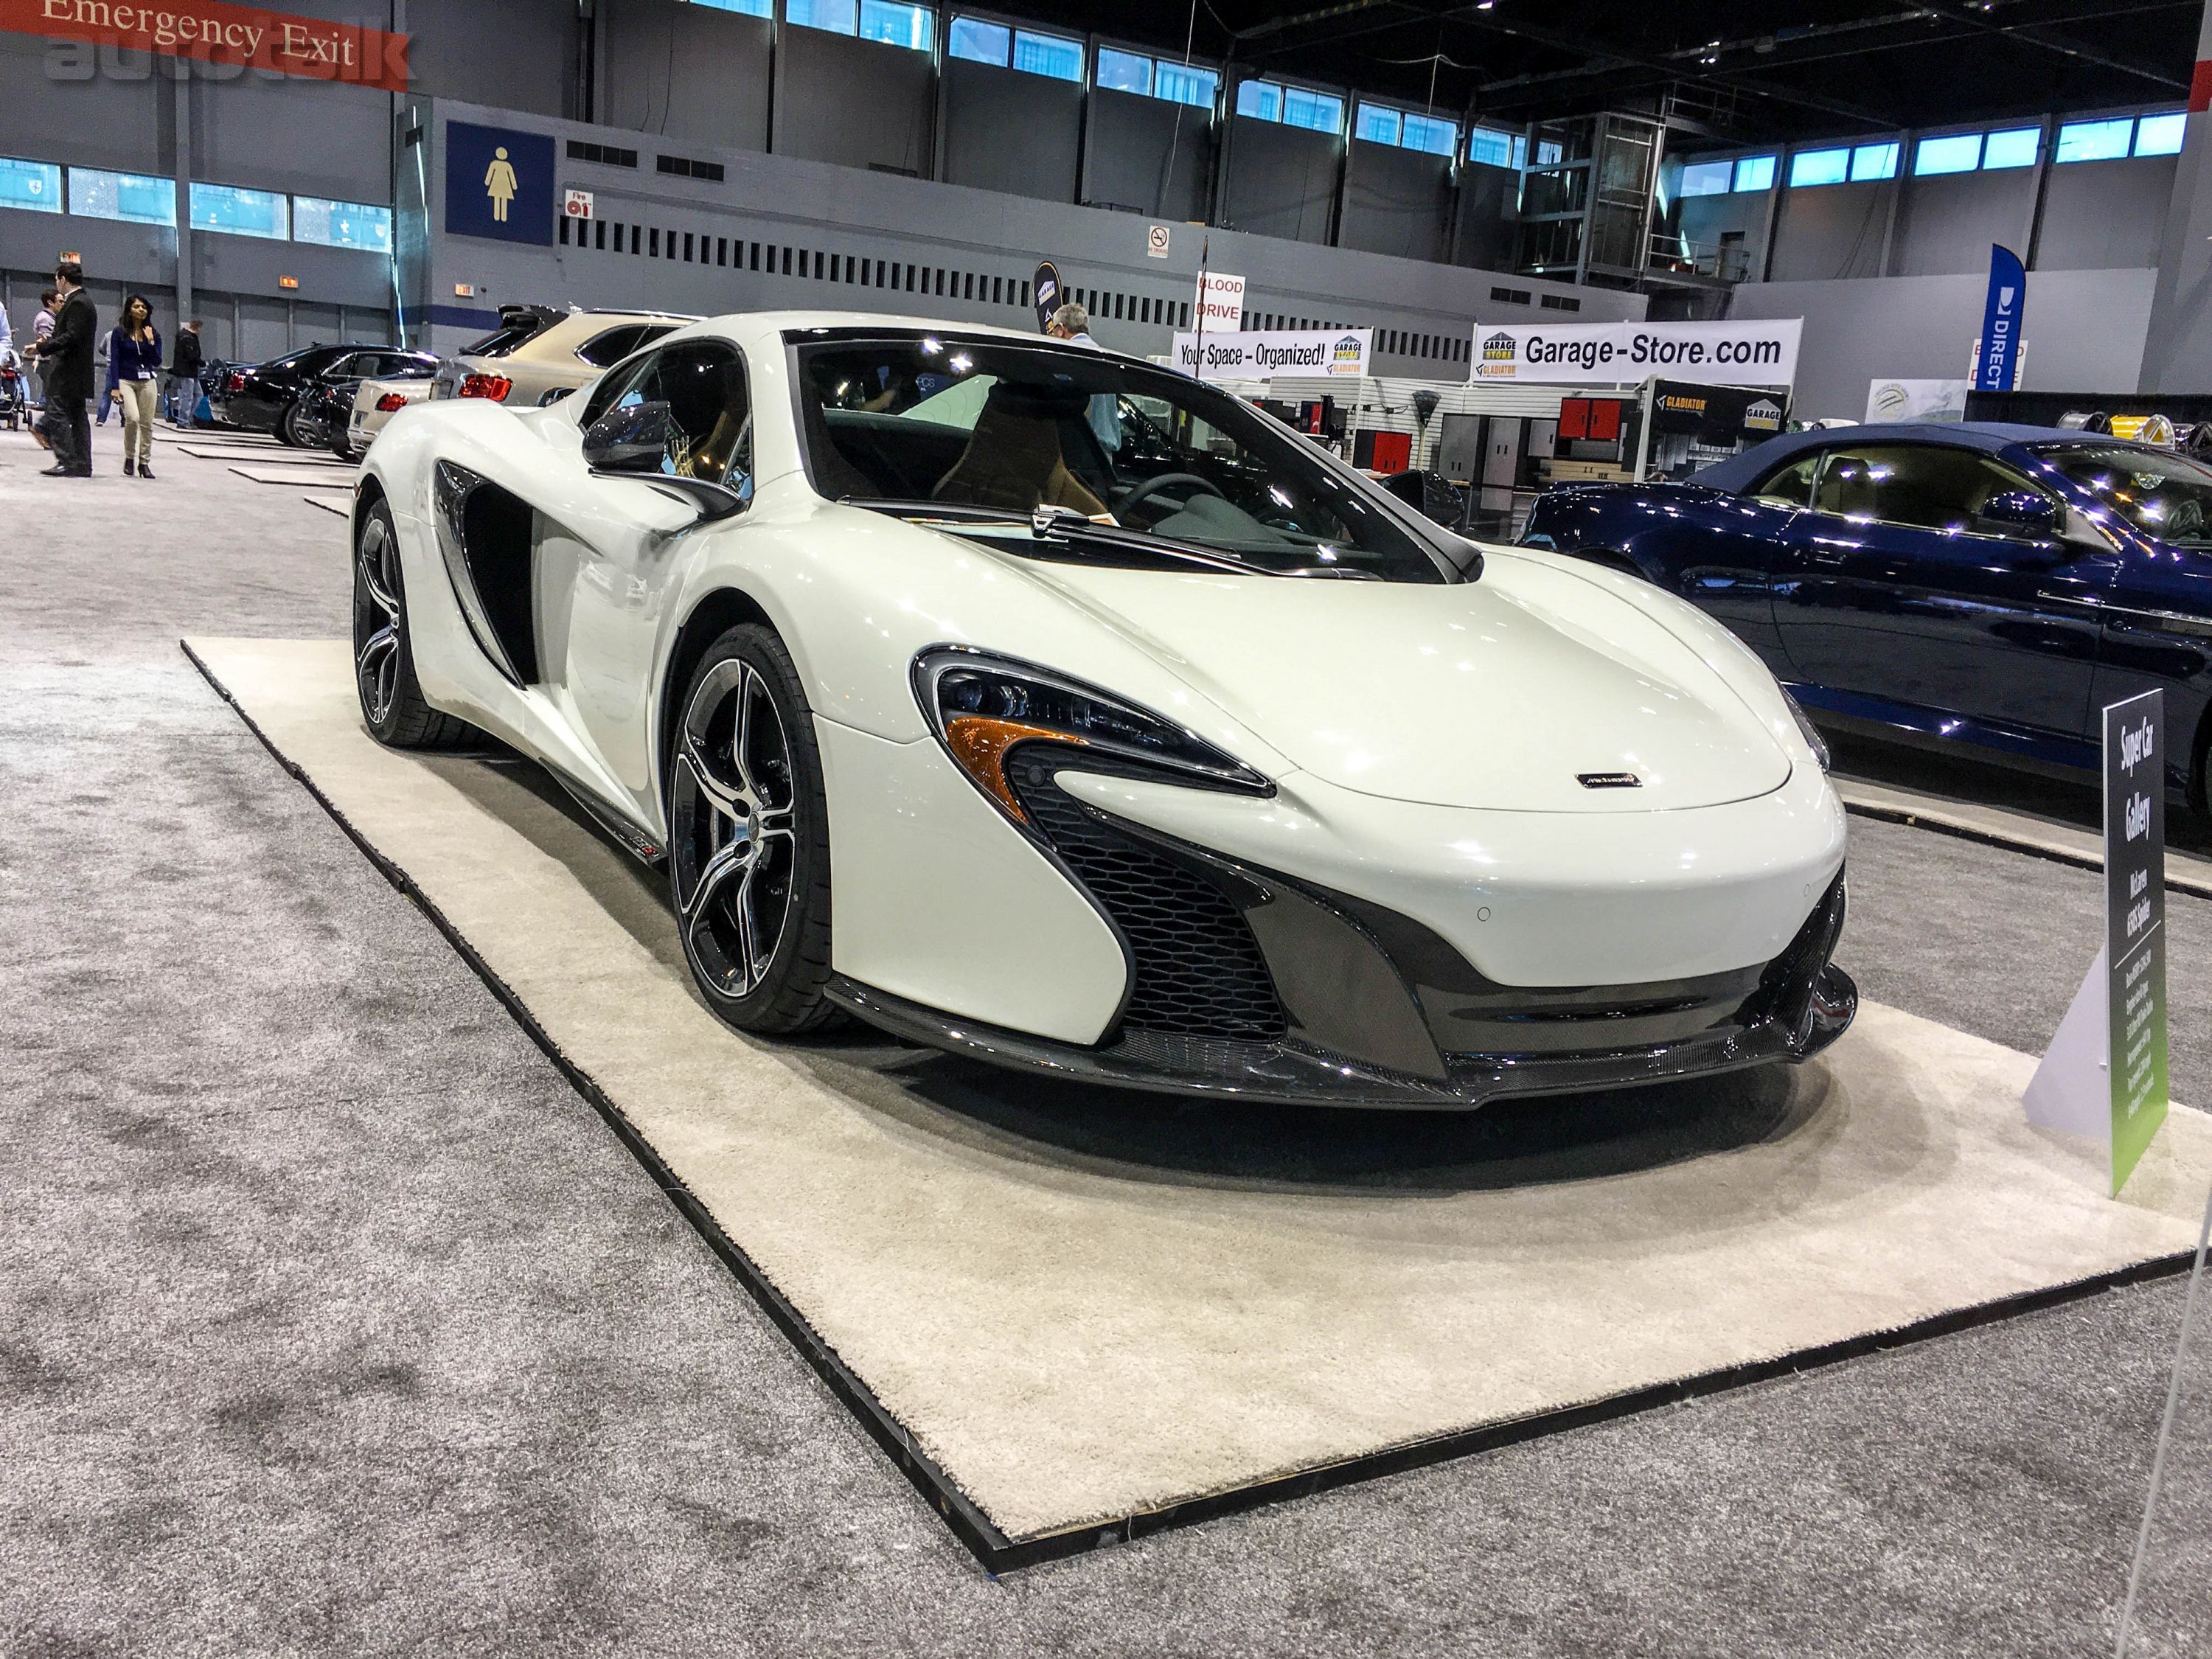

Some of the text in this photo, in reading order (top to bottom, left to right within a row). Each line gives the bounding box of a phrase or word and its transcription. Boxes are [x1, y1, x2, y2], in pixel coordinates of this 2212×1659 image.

[280, 23, 354, 66] Exit
[1199, 277, 1242, 293] BLOOD
[1197, 303, 1239, 319] DRIVE
[1484, 341, 1516, 349] GARAGE
[1526, 334, 1781, 369] Garage-Store.com
[1181, 344, 1205, 365] Your
[1207, 344, 1242, 369] Space
[1256, 343, 1325, 369] Organized!
[1484, 366, 1516, 374] GLADIATOR
[1666, 396, 1705, 411] GLADIATOR
[1747, 408, 1781, 420] GARAGE
[2121, 716, 2153, 777] Super Car
[2126, 791, 2150, 842] Gallery
